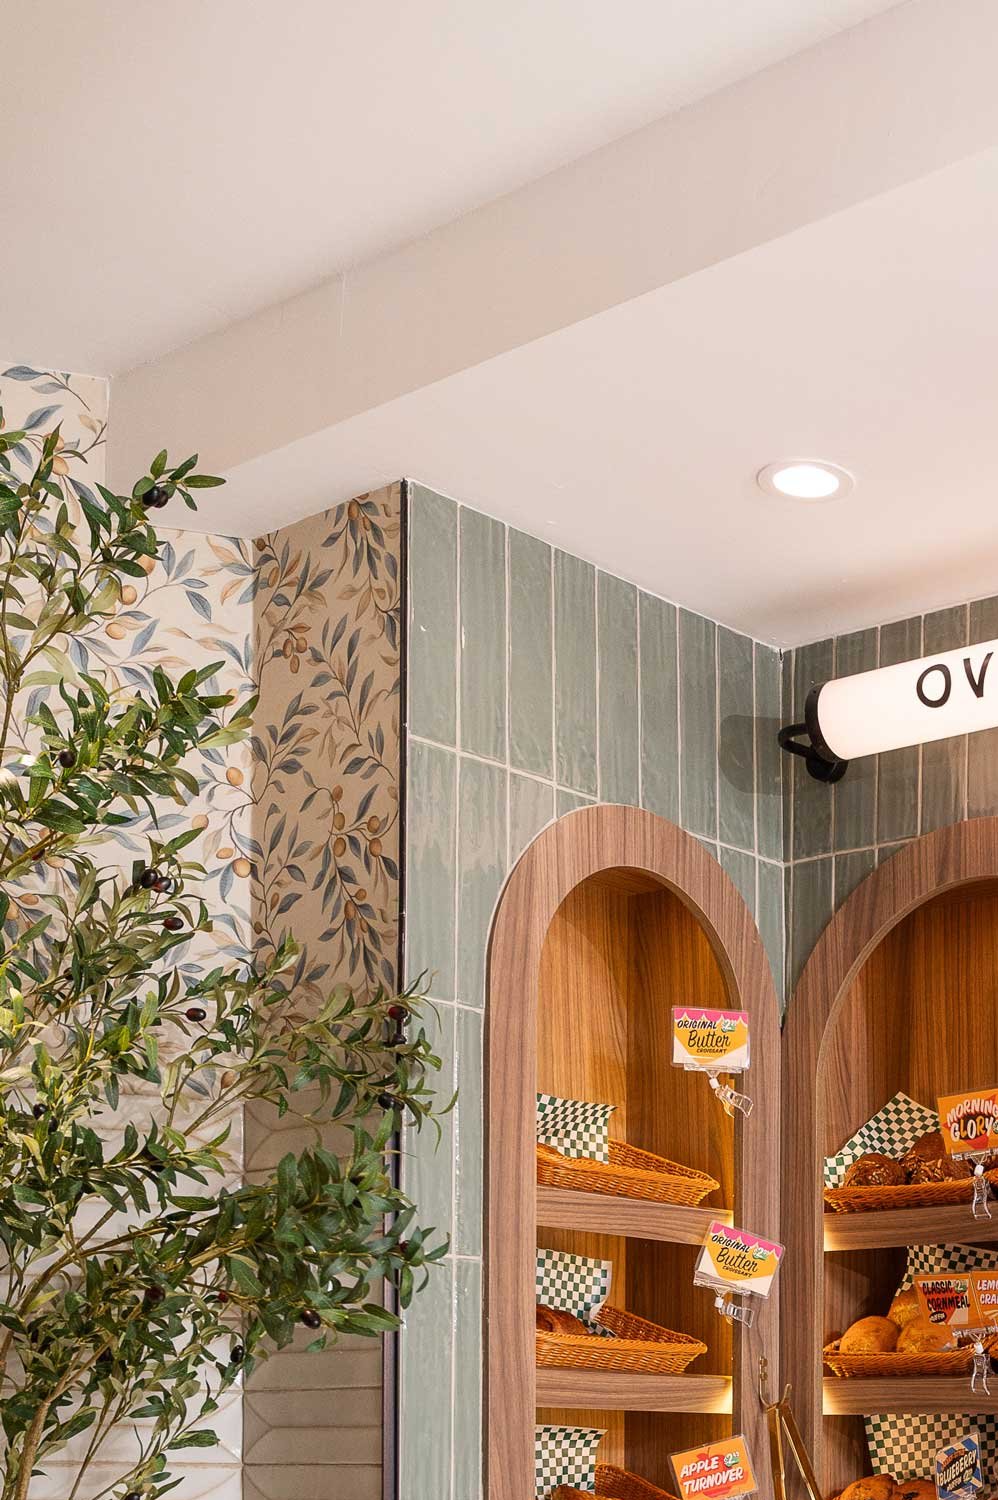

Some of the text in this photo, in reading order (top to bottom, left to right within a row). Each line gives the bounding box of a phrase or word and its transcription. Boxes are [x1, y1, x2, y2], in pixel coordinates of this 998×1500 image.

[677, 1019, 717, 1029] ORIGINAL
[687, 1029, 731, 1048] Butter
[950, 1115, 994, 1142] GLORY
[711, 1234, 751, 1254] ORIGINAL
[716, 1247, 758, 1273] Butter
[680, 1456, 719, 1478] APPLE
[939, 1449, 977, 1488] BLUEBERRY
[683, 1466, 744, 1494] TURNOVER
